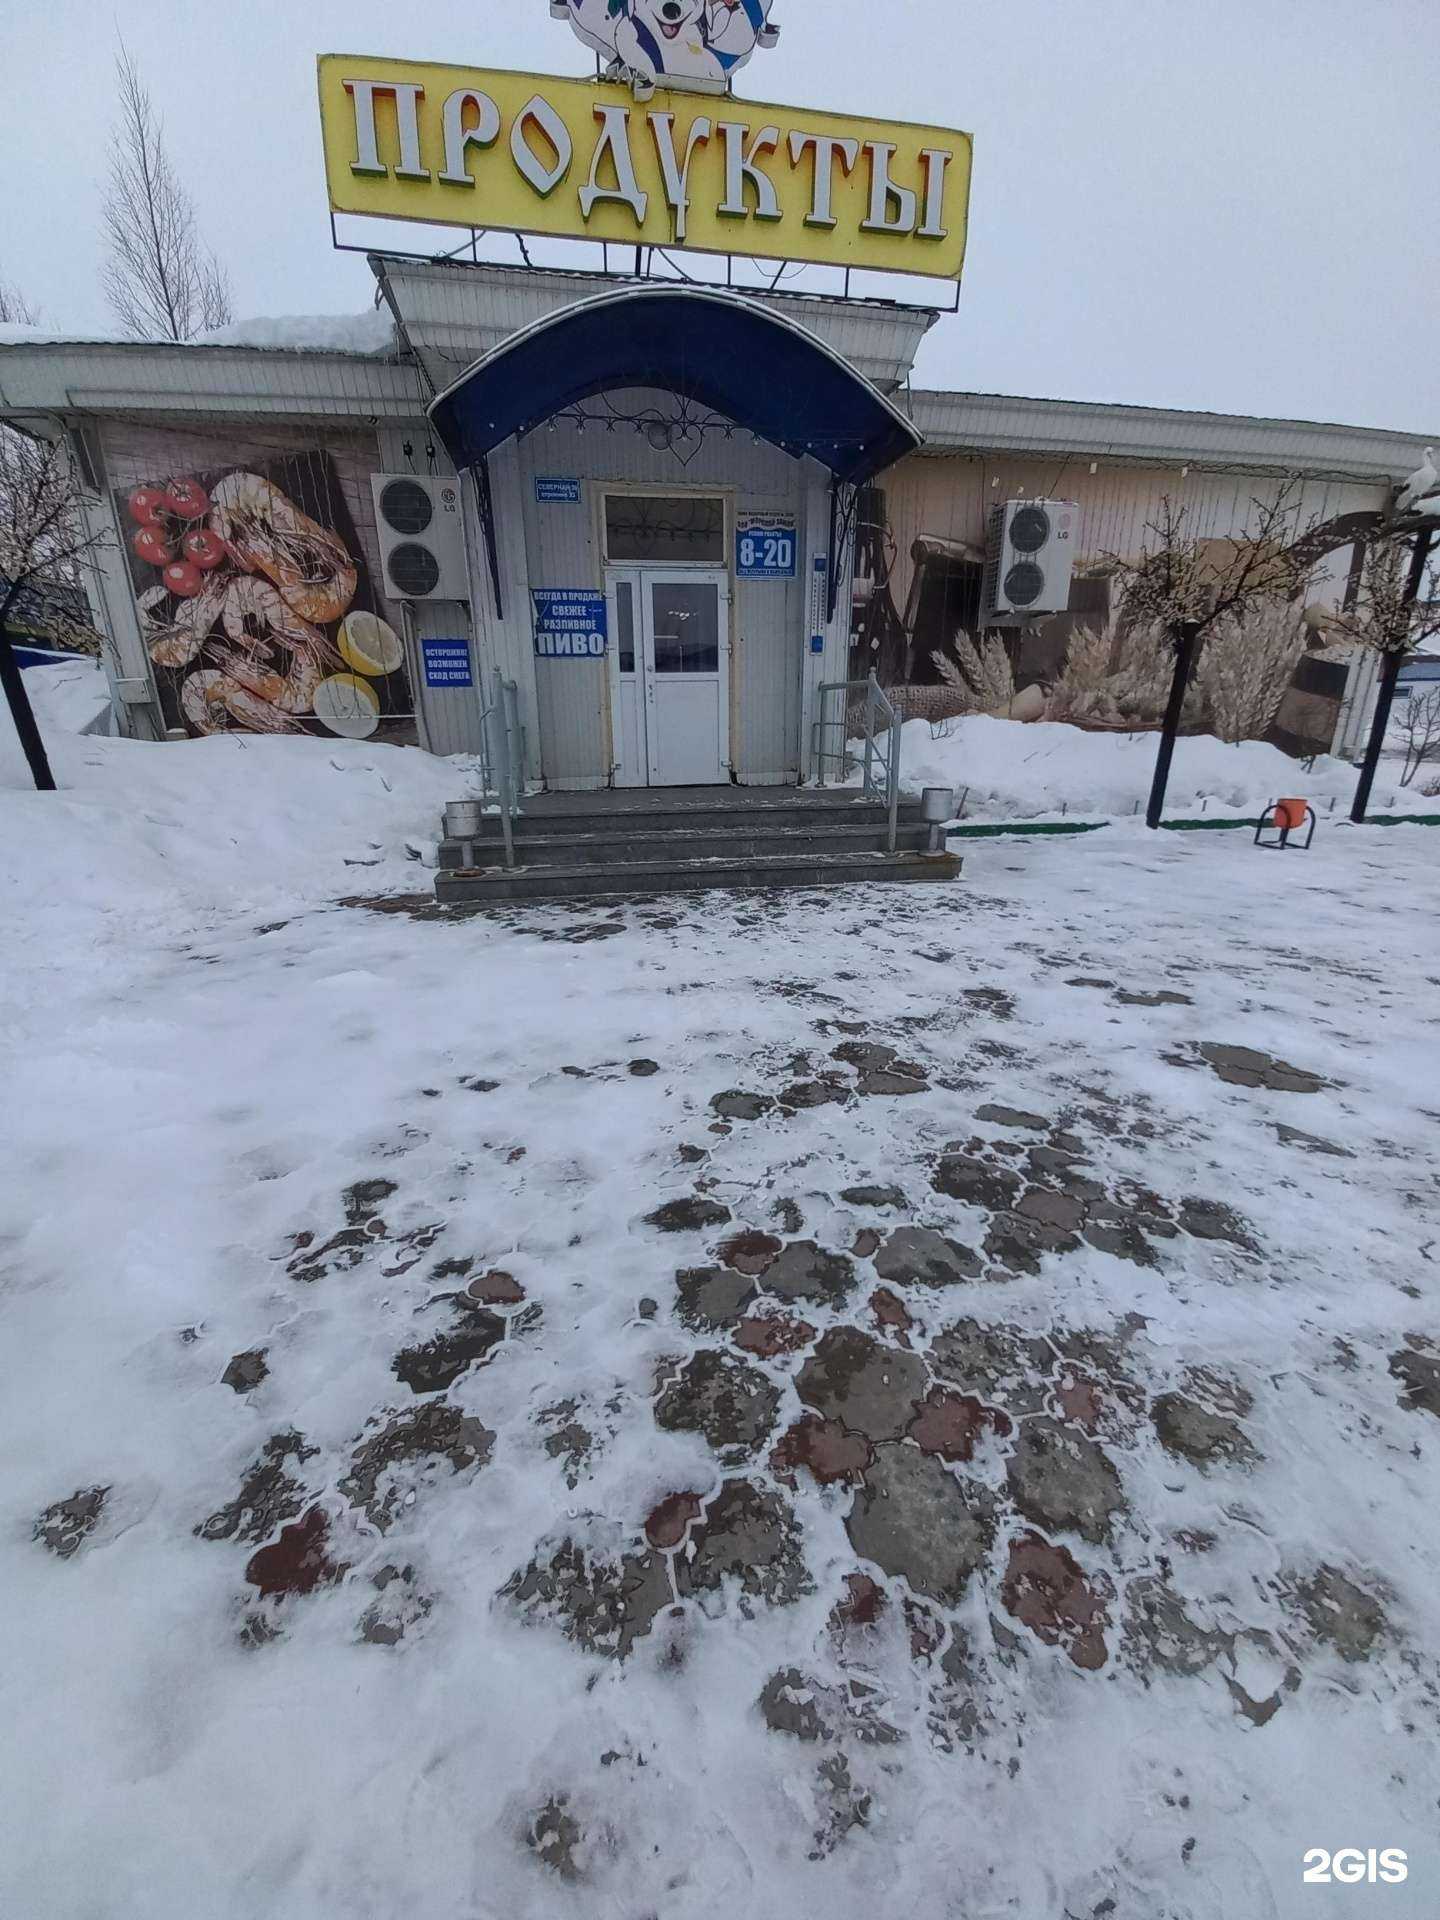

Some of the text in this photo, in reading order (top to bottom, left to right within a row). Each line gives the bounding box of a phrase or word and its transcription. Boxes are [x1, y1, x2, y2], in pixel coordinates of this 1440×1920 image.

[342, 79, 953, 242] ПРОДУКТЫ
[1057, 531, 1069, 540] LG
[740, 538, 792, 568] 8-20
[533, 591, 562, 602] ВСЕГДА
[552, 605, 587, 617] СВЕЖЕЕ
[537, 632, 604, 655] ПИВО
